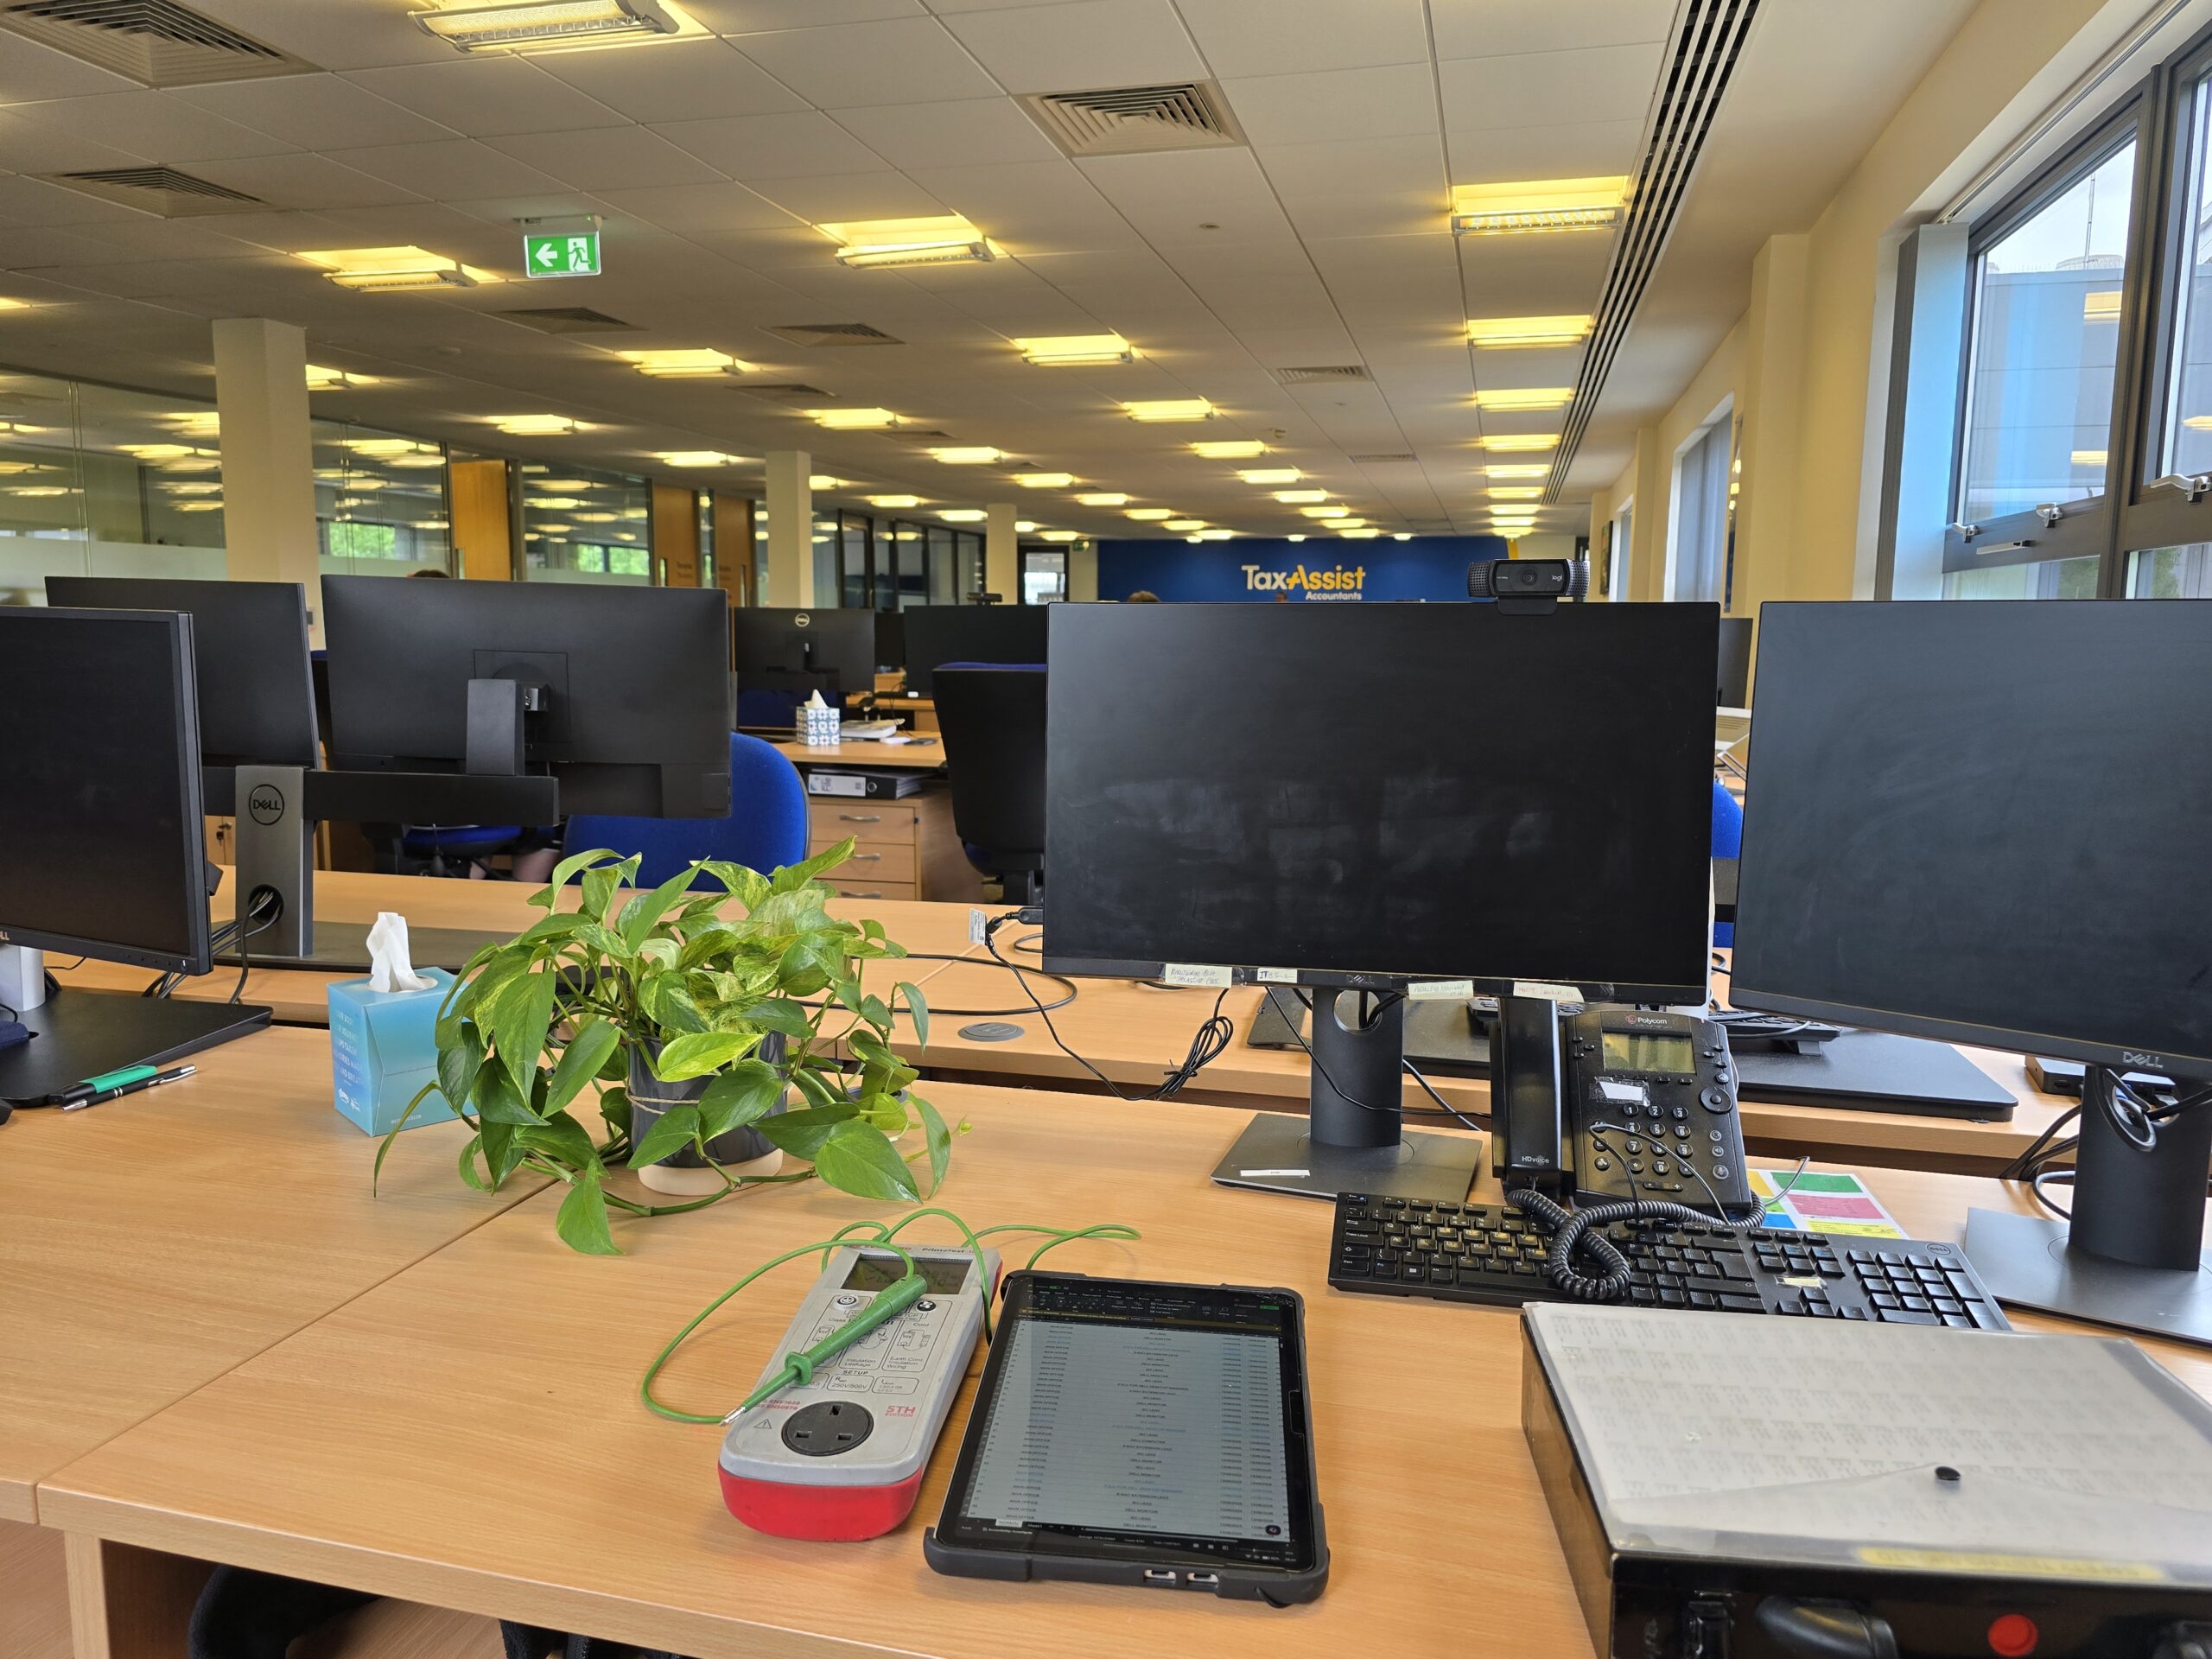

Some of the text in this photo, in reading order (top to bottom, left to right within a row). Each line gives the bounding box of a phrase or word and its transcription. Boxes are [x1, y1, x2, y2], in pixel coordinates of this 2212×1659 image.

[1241, 564, 1366, 590] TaxAssist
[1306, 591, 1362, 601] Accountants
[253, 799, 281, 810] DELL
[1346, 975, 1374, 983] DELL
[2122, 1052, 2164, 1068] DELL
[886, 1405, 917, 1414] 5TH
